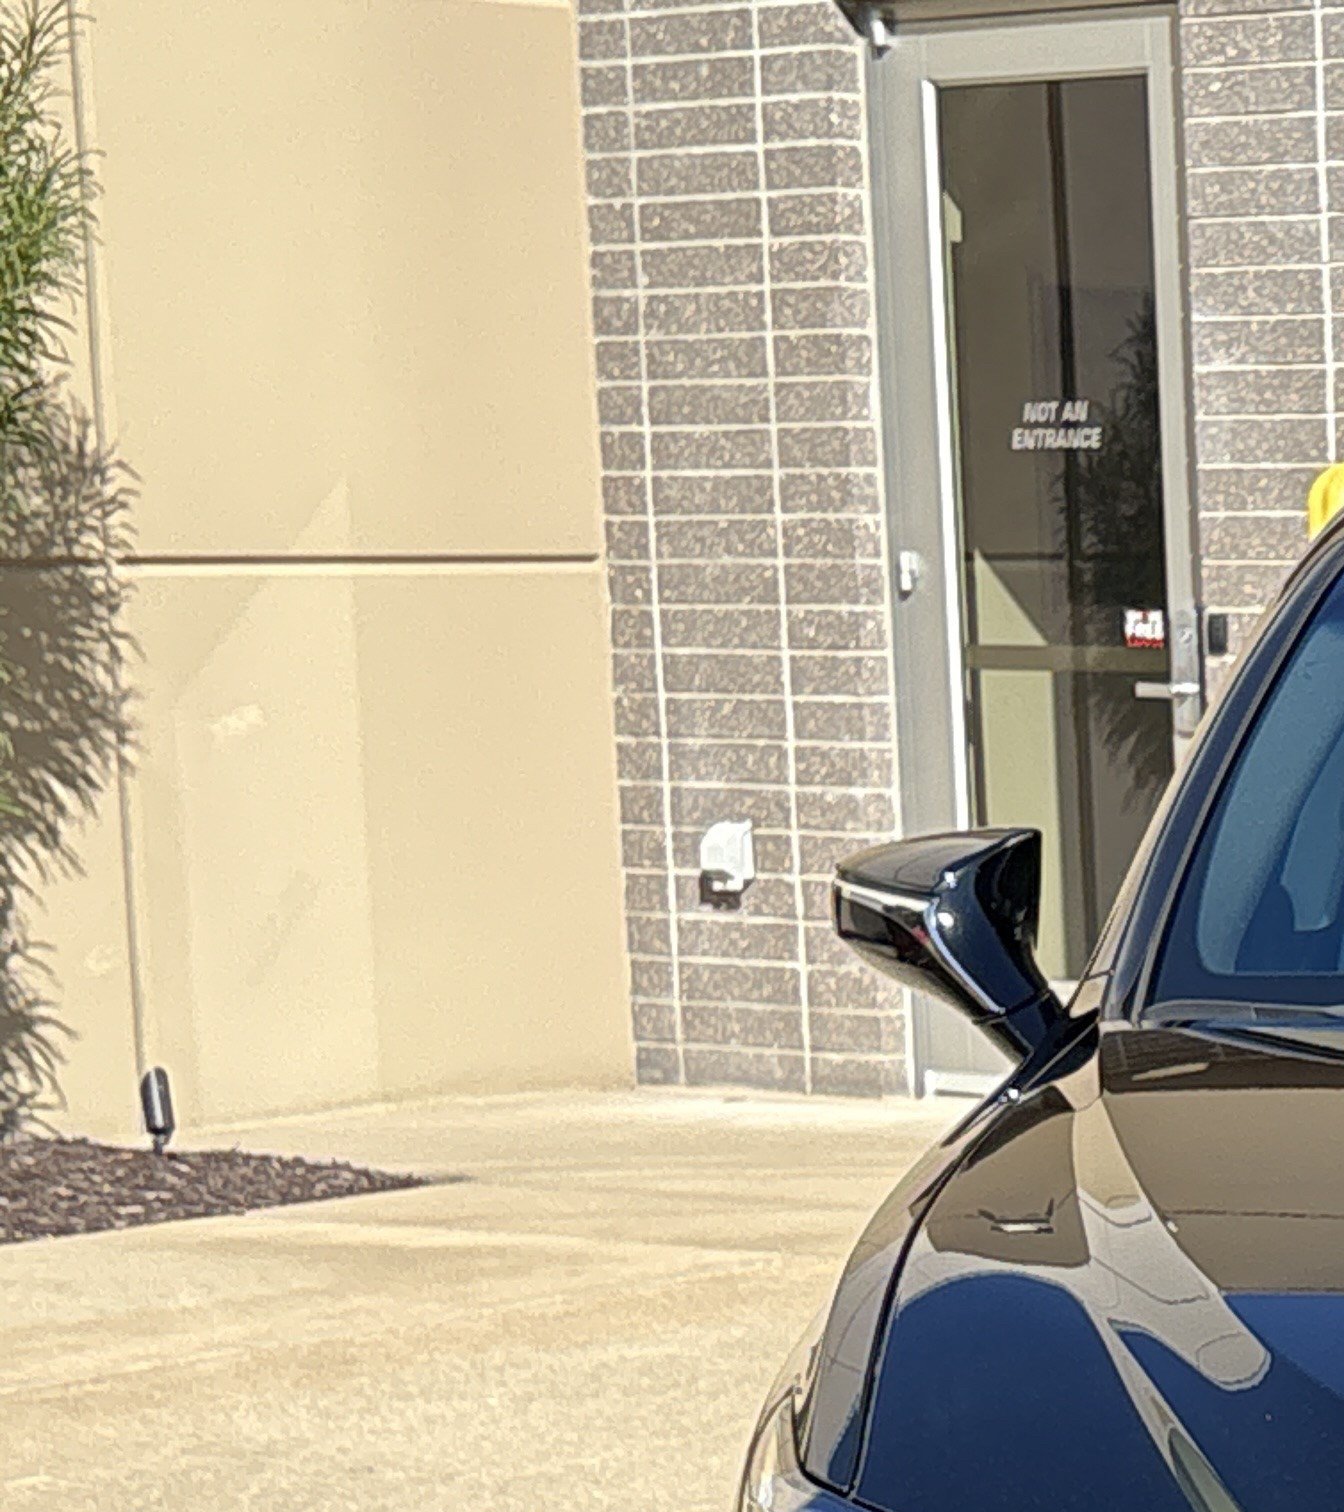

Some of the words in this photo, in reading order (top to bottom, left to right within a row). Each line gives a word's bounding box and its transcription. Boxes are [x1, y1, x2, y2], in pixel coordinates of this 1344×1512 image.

[1023, 401, 1060, 422] NOT
[1061, 400, 1089, 421] AN
[1011, 427, 1102, 450] ENTRANCE
